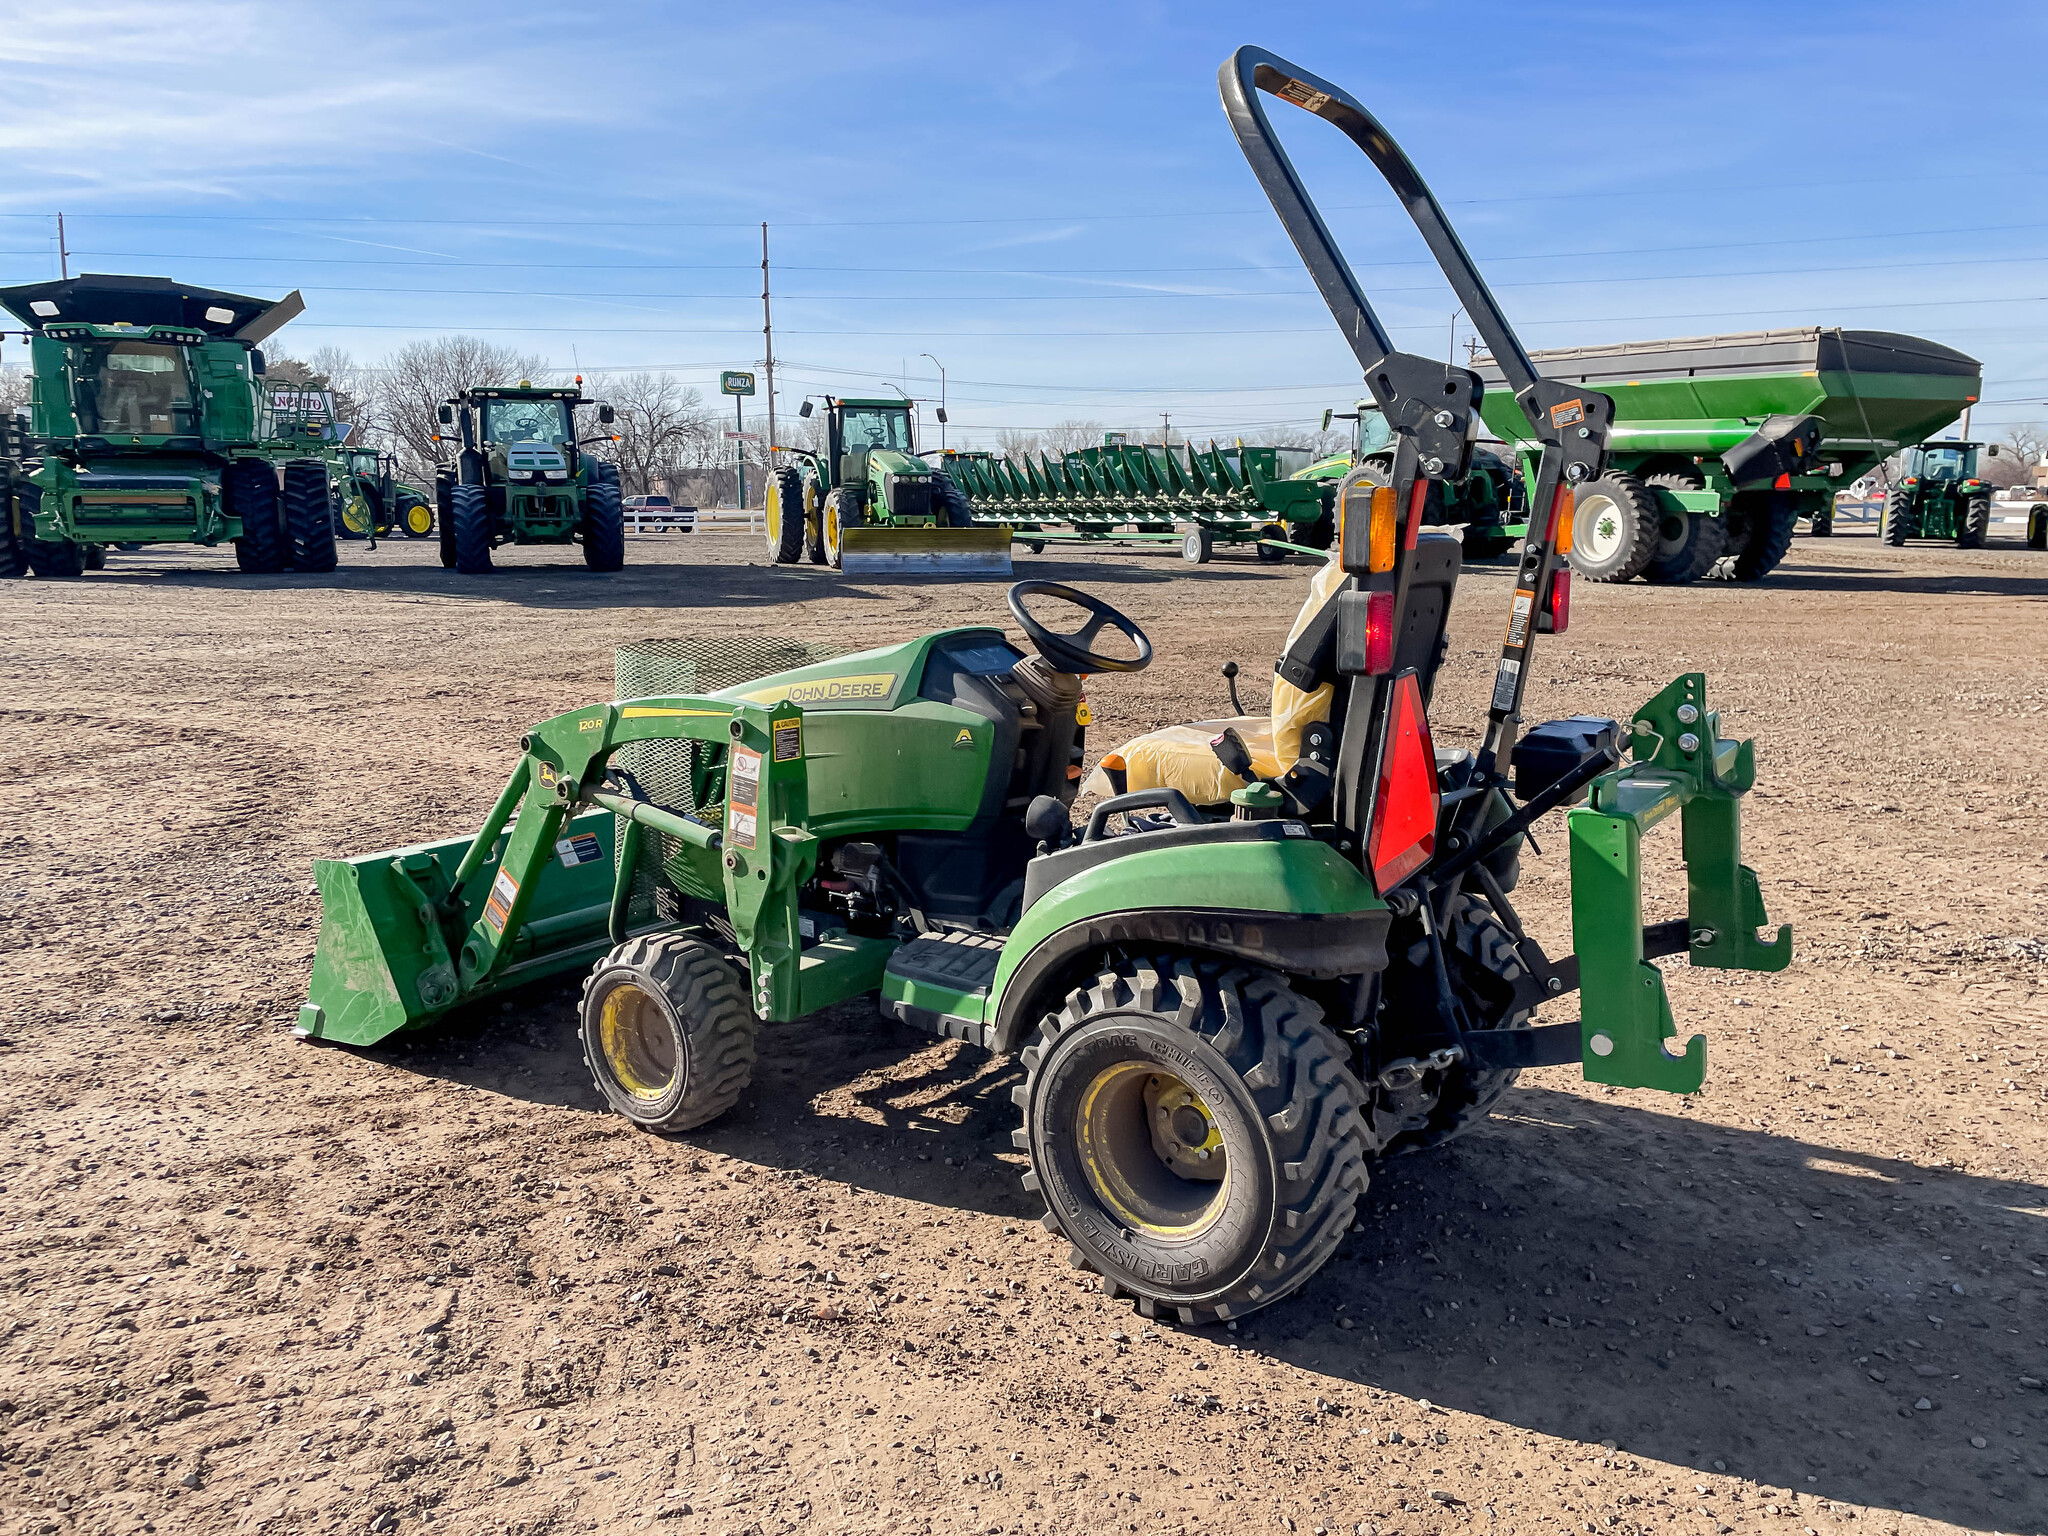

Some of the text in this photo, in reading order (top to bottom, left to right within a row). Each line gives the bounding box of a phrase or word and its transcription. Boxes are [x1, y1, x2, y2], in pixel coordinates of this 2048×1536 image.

[727, 377, 751, 388] RUNZA
[787, 683, 884, 701] JOHN DEERE
[1083, 1034, 1213, 1087] TRAC CHIEF
[1077, 1214, 1210, 1282] CARLISLE
